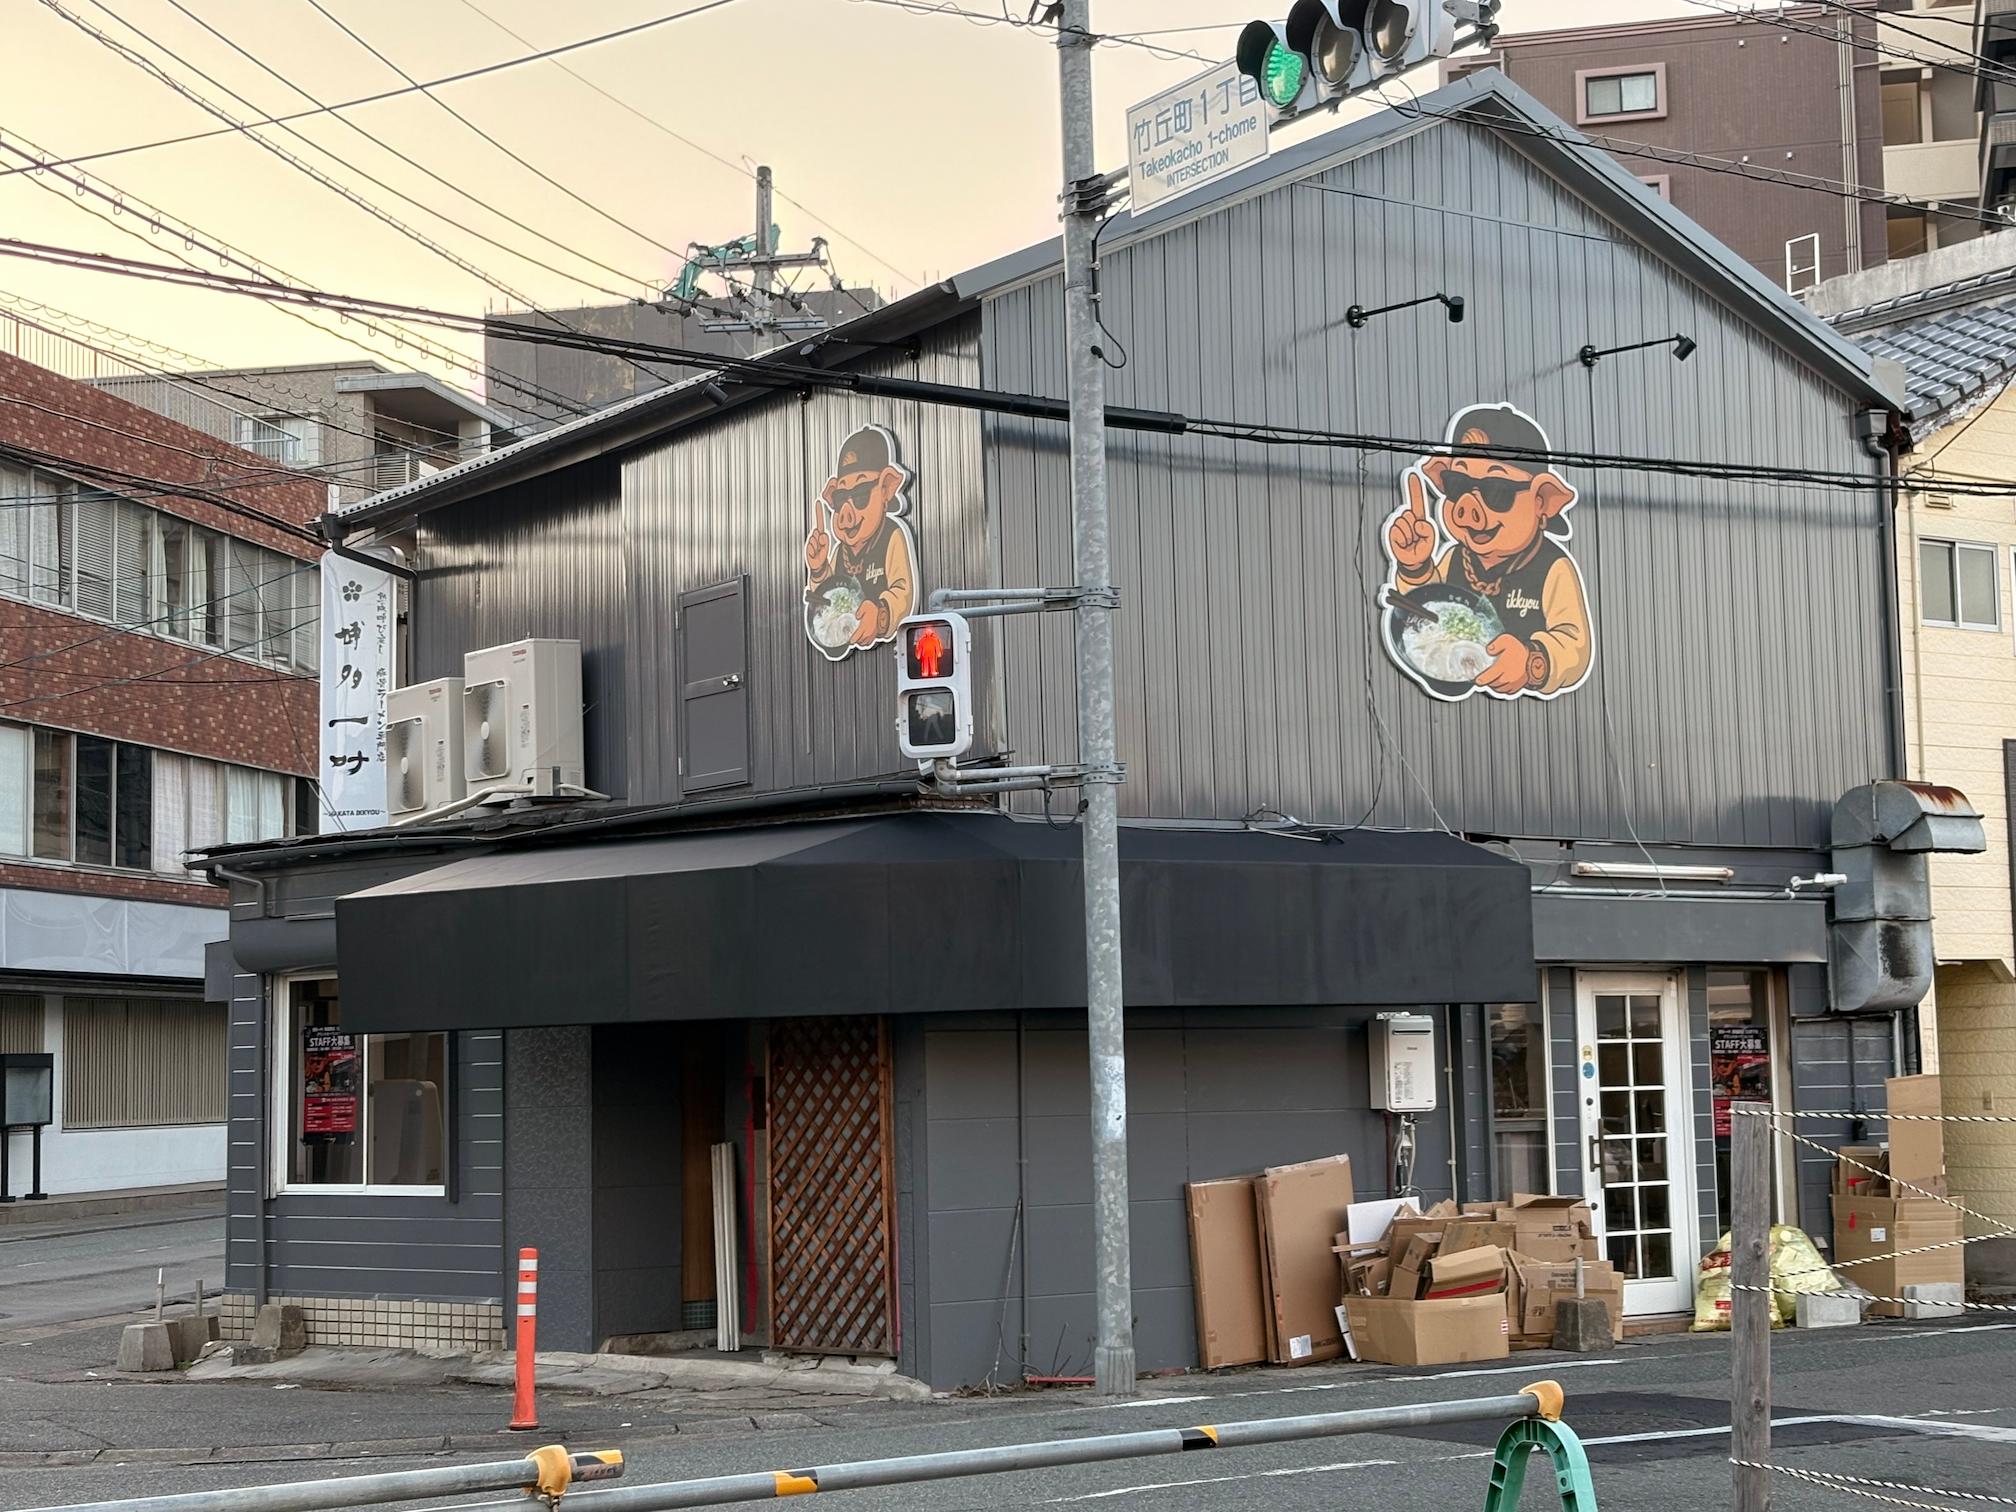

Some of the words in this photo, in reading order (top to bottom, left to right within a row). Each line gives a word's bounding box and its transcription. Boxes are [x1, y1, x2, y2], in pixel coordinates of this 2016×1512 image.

[1133, 74, 1258, 155] 竹丘町1丁目
[1138, 140, 1203, 180] Takeokacho
[1207, 116, 1257, 149] 1-chome
[1166, 148, 1230, 189] INTERSECTION
[1505, 588, 1540, 618] ikkyou
